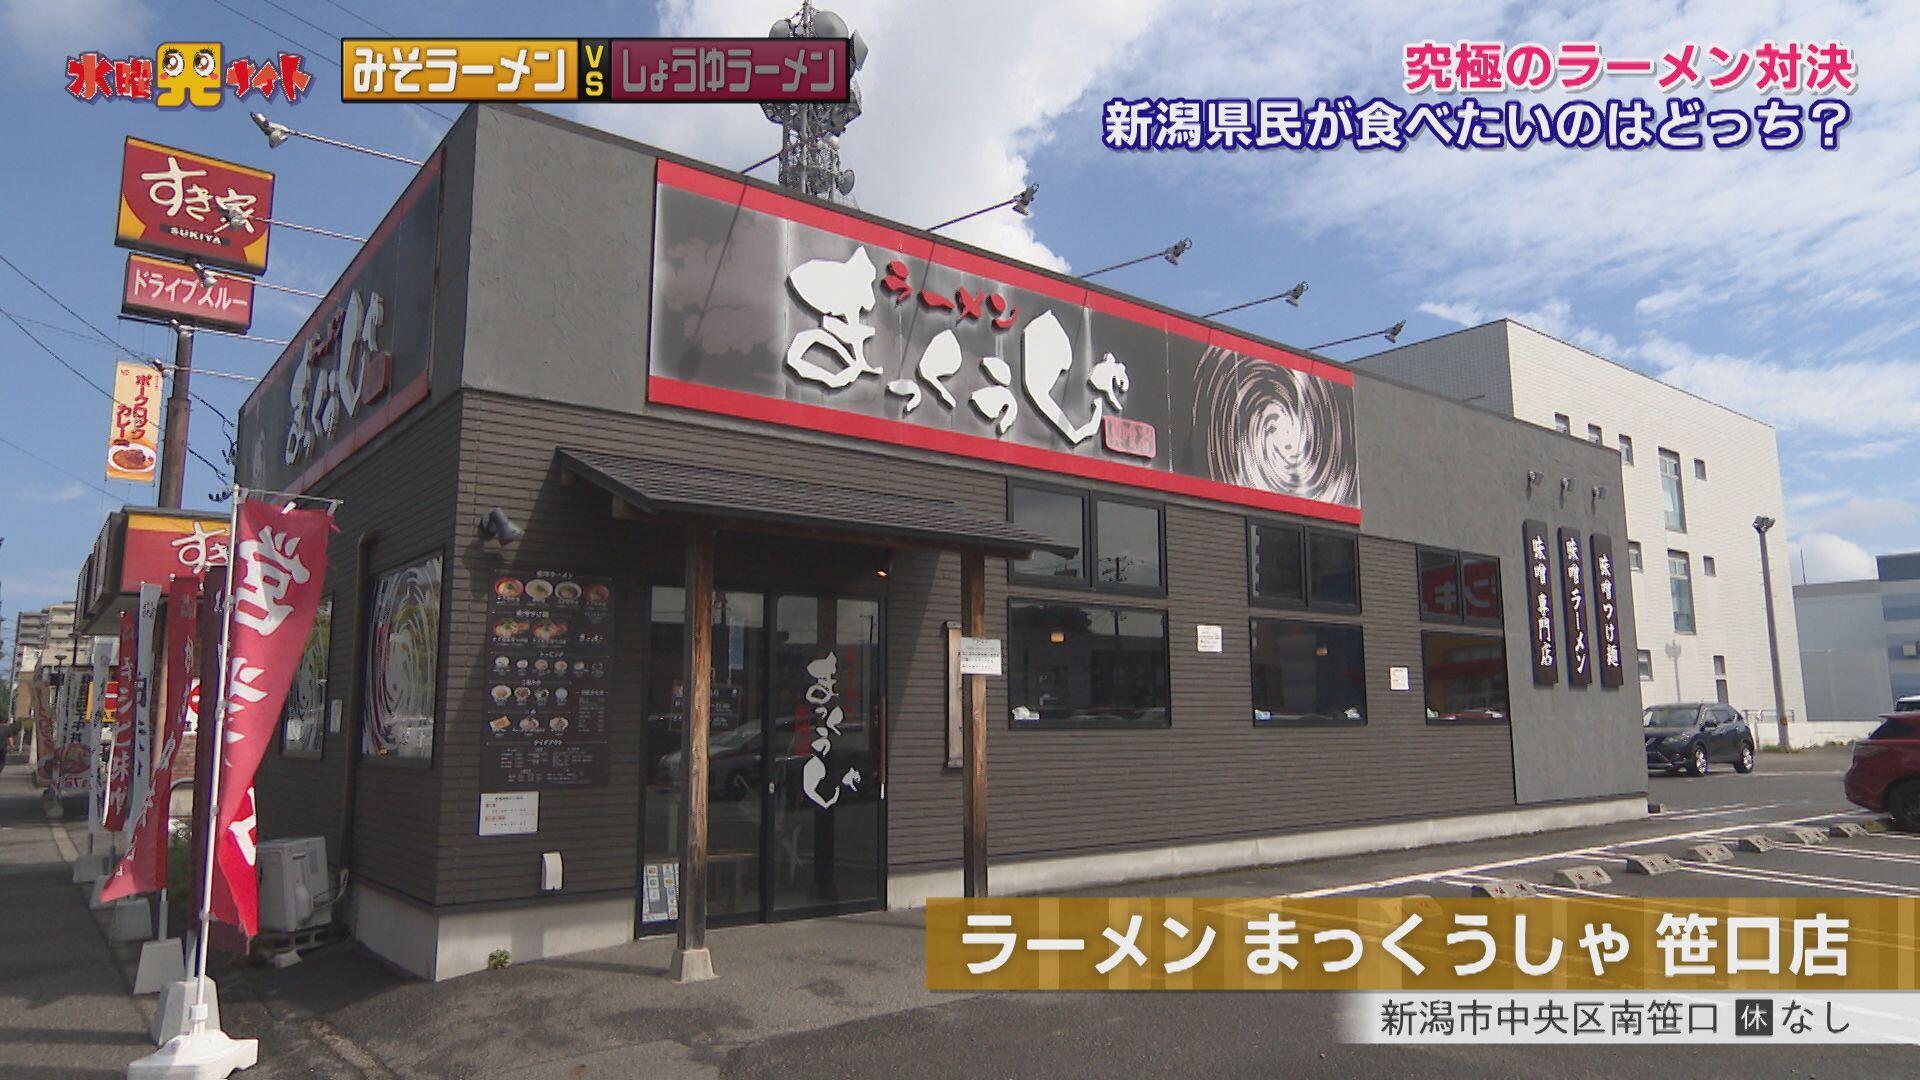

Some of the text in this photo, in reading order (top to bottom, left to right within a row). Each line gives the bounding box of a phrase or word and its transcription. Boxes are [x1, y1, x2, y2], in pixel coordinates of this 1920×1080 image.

[141, 157, 256, 233] すき家
[170, 225, 221, 245] SUKIYA
[134, 269, 247, 310] ドライブスルー
[880, 260, 1019, 330] ラーメン
[785, 246, 1130, 444] まっくうしゃ
[116, 403, 132, 438] カレー
[1566, 537, 1590, 674] 味噌ラーメン
[805, 651, 862, 810] まっくうしゃ
